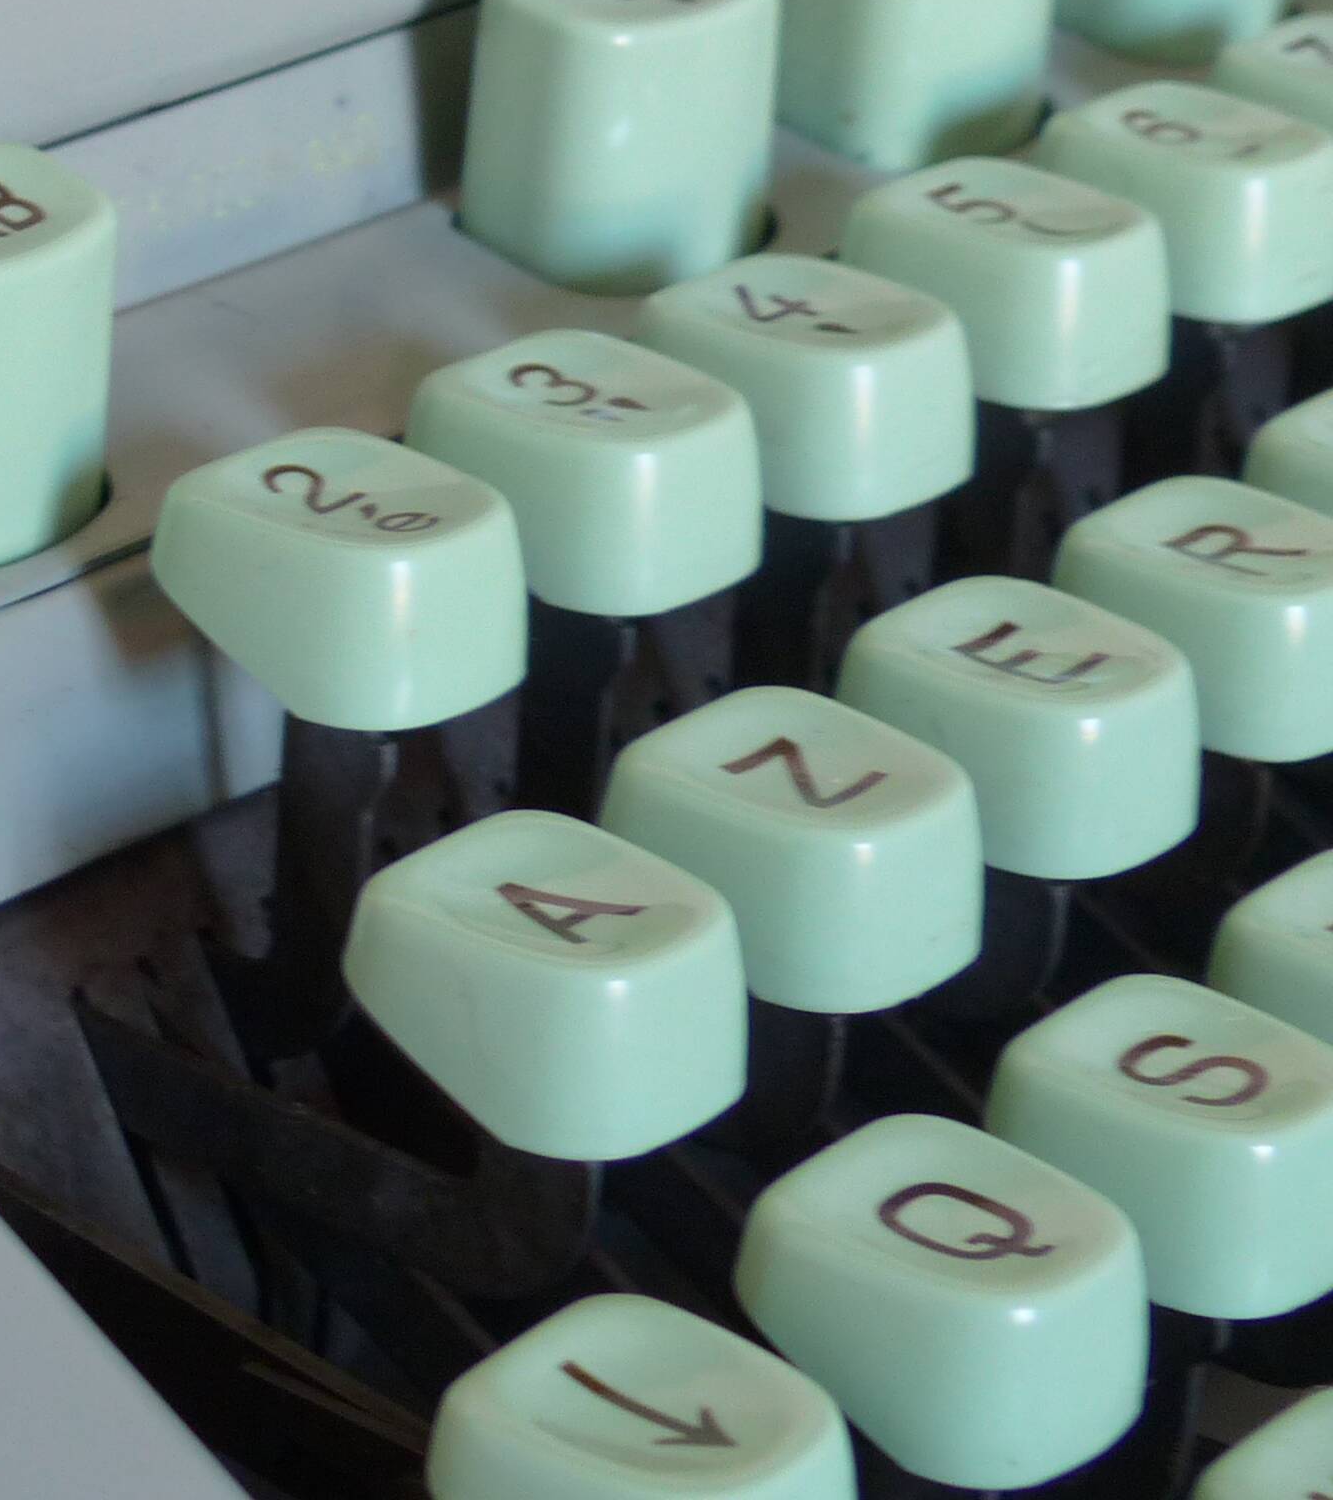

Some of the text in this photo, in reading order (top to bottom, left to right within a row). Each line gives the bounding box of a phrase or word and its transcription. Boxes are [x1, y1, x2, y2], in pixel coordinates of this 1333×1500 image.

[926, 182, 1017, 224] 5
[734, 284, 819, 323] 4
[508, 362, 598, 407] 3
[263, 464, 367, 515] 2
[1163, 524, 1308, 577] R
[951, 621, 1111, 684] E
[721, 736, 888, 809] Z
[495, 881, 647, 944] A
[1118, 1034, 1270, 1107] S
[878, 1181, 1053, 1260] Q
